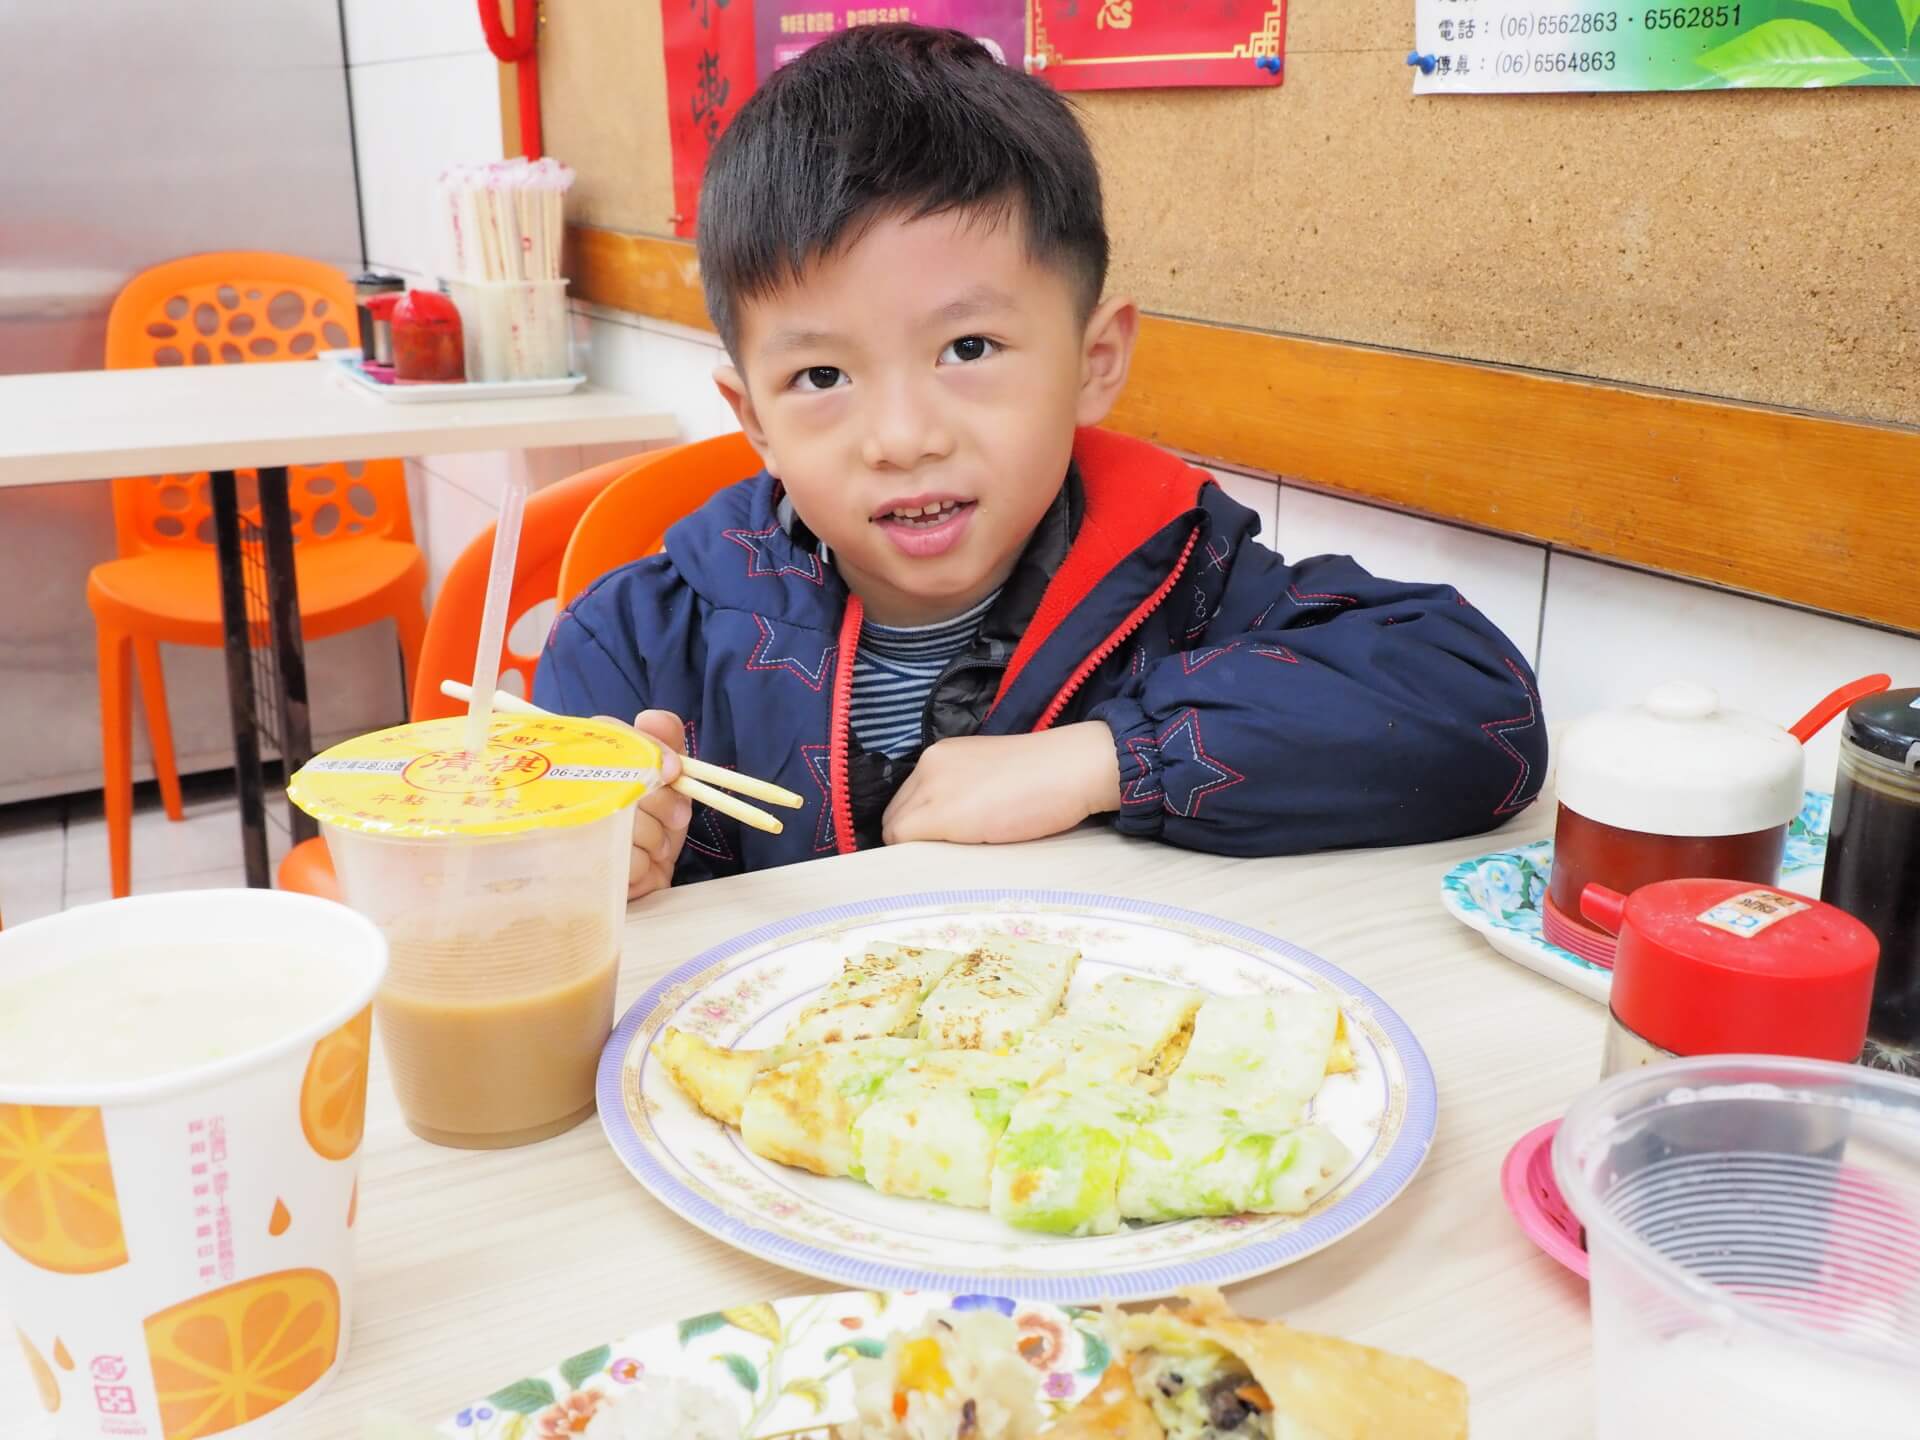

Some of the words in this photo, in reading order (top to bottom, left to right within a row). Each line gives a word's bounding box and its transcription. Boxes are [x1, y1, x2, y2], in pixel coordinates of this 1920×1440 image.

[1500, 11, 1618, 40] (06)6562863
[1644, 4, 1741, 30] 6562851
[1496, 50, 1616, 77] (06)6564863
[550, 768, 640, 779] 06-2285781
